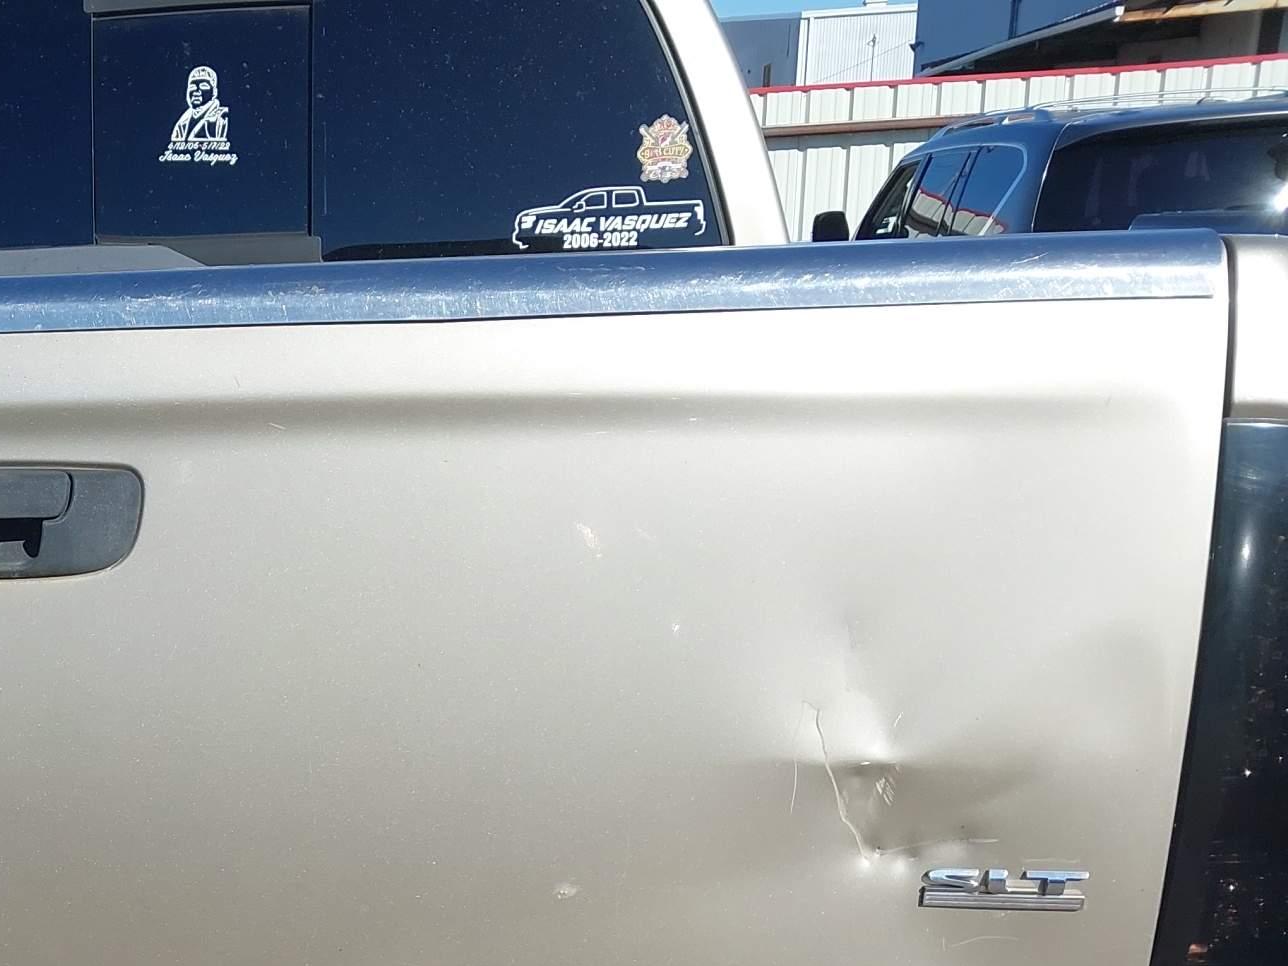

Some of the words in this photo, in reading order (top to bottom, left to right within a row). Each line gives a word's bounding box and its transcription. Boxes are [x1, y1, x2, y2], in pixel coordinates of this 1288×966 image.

[158, 150, 192, 162] Isaac
[194, 150, 238, 166] Vasquez
[534, 215, 596, 234] ISAAC
[599, 212, 692, 233] VASQUEZ
[563, 231, 638, 249] 2006-2022
[920, 867, 1090, 899] SLT
